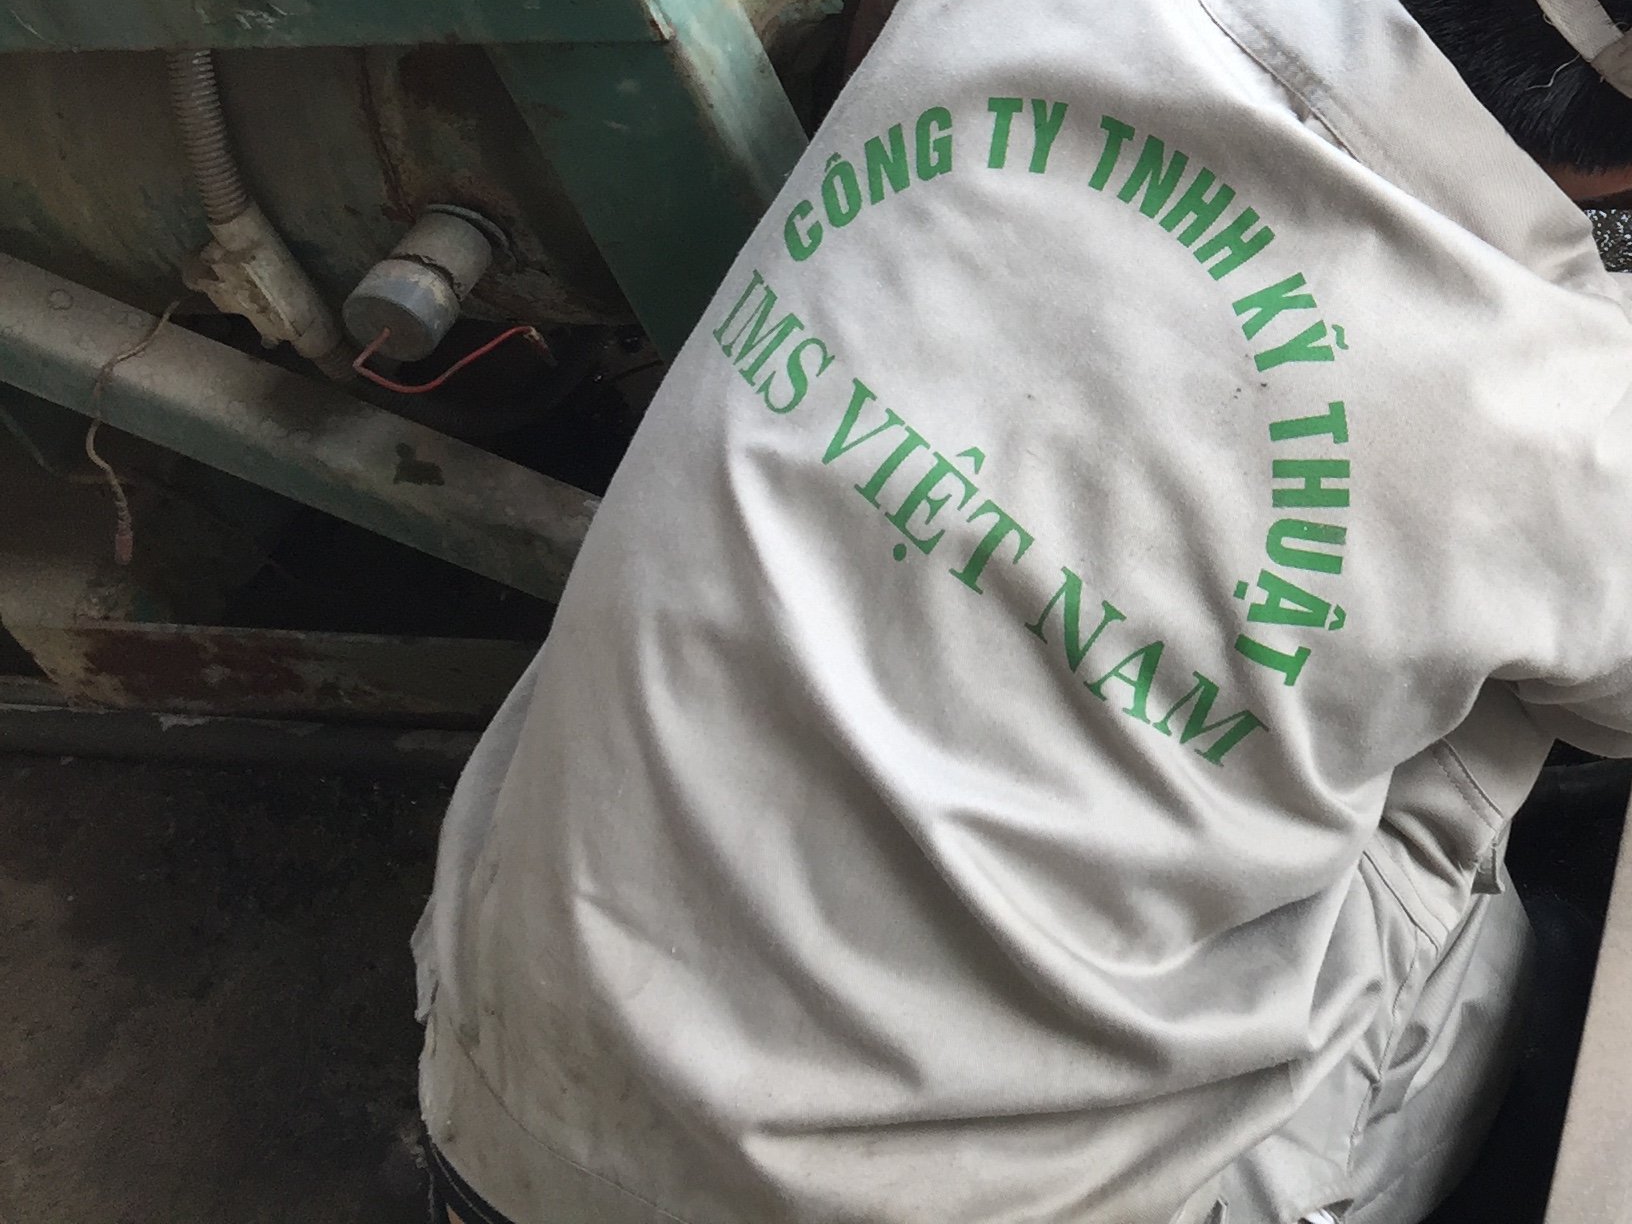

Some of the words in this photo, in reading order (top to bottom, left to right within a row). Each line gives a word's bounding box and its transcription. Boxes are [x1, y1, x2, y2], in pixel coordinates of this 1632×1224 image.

[784, 107, 952, 262] CÔNG
[988, 97, 1068, 174] TY
[1088, 116, 1275, 281] TNHH
[1232, 272, 1348, 372] KỸ
[712, 270, 835, 414] IMS
[821, 378, 1034, 594] VIỆT
[1024, 567, 1269, 767] NAM
[1234, 401, 1350, 686] THUẬT
